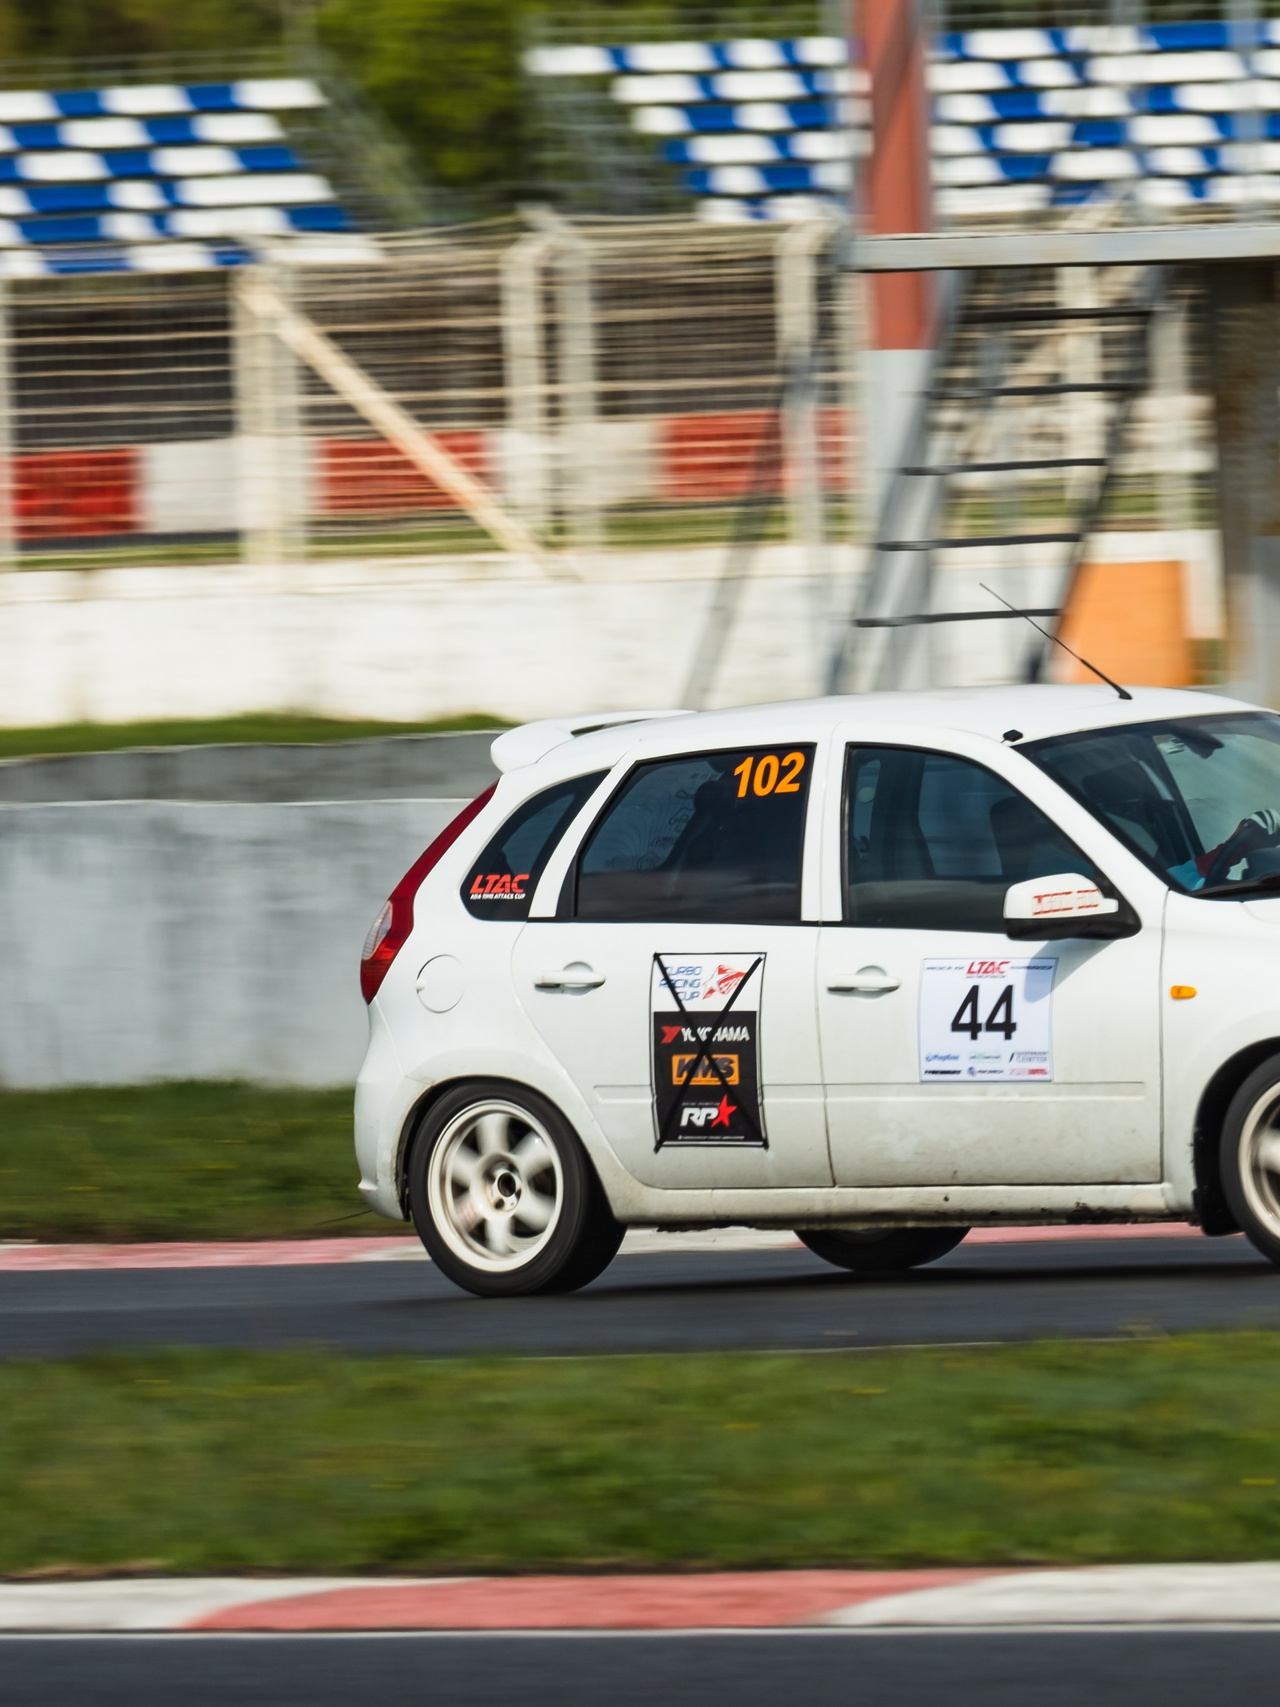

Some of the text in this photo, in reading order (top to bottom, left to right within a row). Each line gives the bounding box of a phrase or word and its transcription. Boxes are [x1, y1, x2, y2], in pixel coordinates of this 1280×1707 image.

[734, 751, 806, 798] 102
[470, 874, 530, 893] LTAC
[966, 961, 1010, 974] LTAC
[951, 984, 1017, 1040] 44
[680, 1107, 719, 1127] RP
